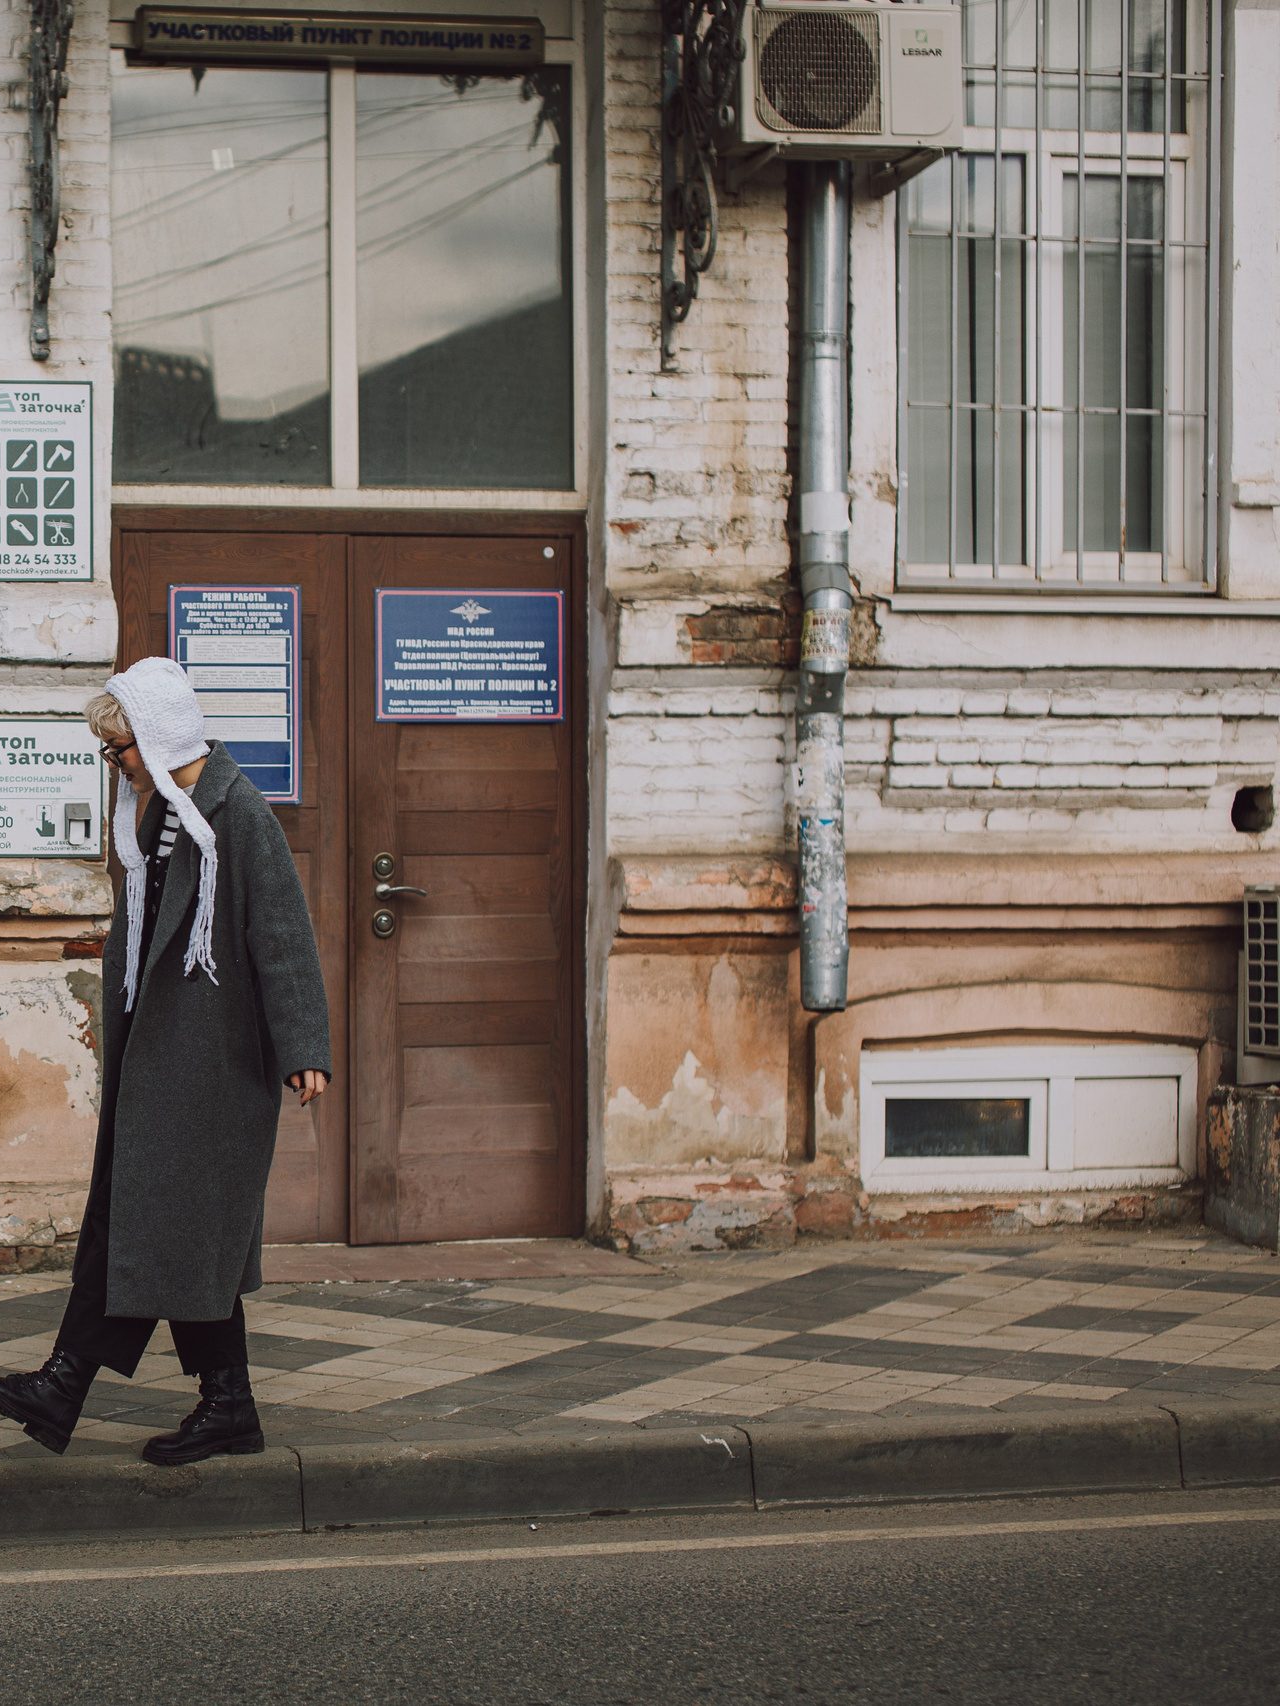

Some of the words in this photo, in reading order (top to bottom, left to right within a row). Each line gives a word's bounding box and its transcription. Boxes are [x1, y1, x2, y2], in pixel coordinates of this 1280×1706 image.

[148, 22, 295, 43] УЧАСТКОВЫЙ
[302, 26, 373, 46] ПУНКТ
[380, 29, 484, 50] ПОЛИЦИИ
[902, 47, 943, 57] LESSAR
[14, 554, 31, 565] 24
[34, 554, 50, 565] 54
[54, 554, 77, 565] 333
[202, 592, 231, 602] РЕЖИМ
[233, 592, 267, 602] РАБОТЫ
[247, 603, 276, 611] ПОЛИЦИИ
[447, 627, 464, 636] МВД
[466, 627, 494, 636] РОССИИ
[405, 639, 422, 648] МВД
[423, 639, 450, 648] России
[460, 640, 524, 649] Краснодарскому
[402, 651, 426, 660] Отдел
[426, 652, 460, 661] полиции
[394, 661, 440, 671] Управления
[440, 662, 457, 671] МВД
[458, 662, 485, 671] России
[502, 663, 547, 672] Краснодару
[384, 677, 452, 691] УЧАСТКОВЫЙ
[455, 679, 486, 691] ПУНКТ
[488, 680, 535, 693] ПОЛИЦИИ
[537, 680, 548, 691] №
[550, 680, 557, 691] 2
